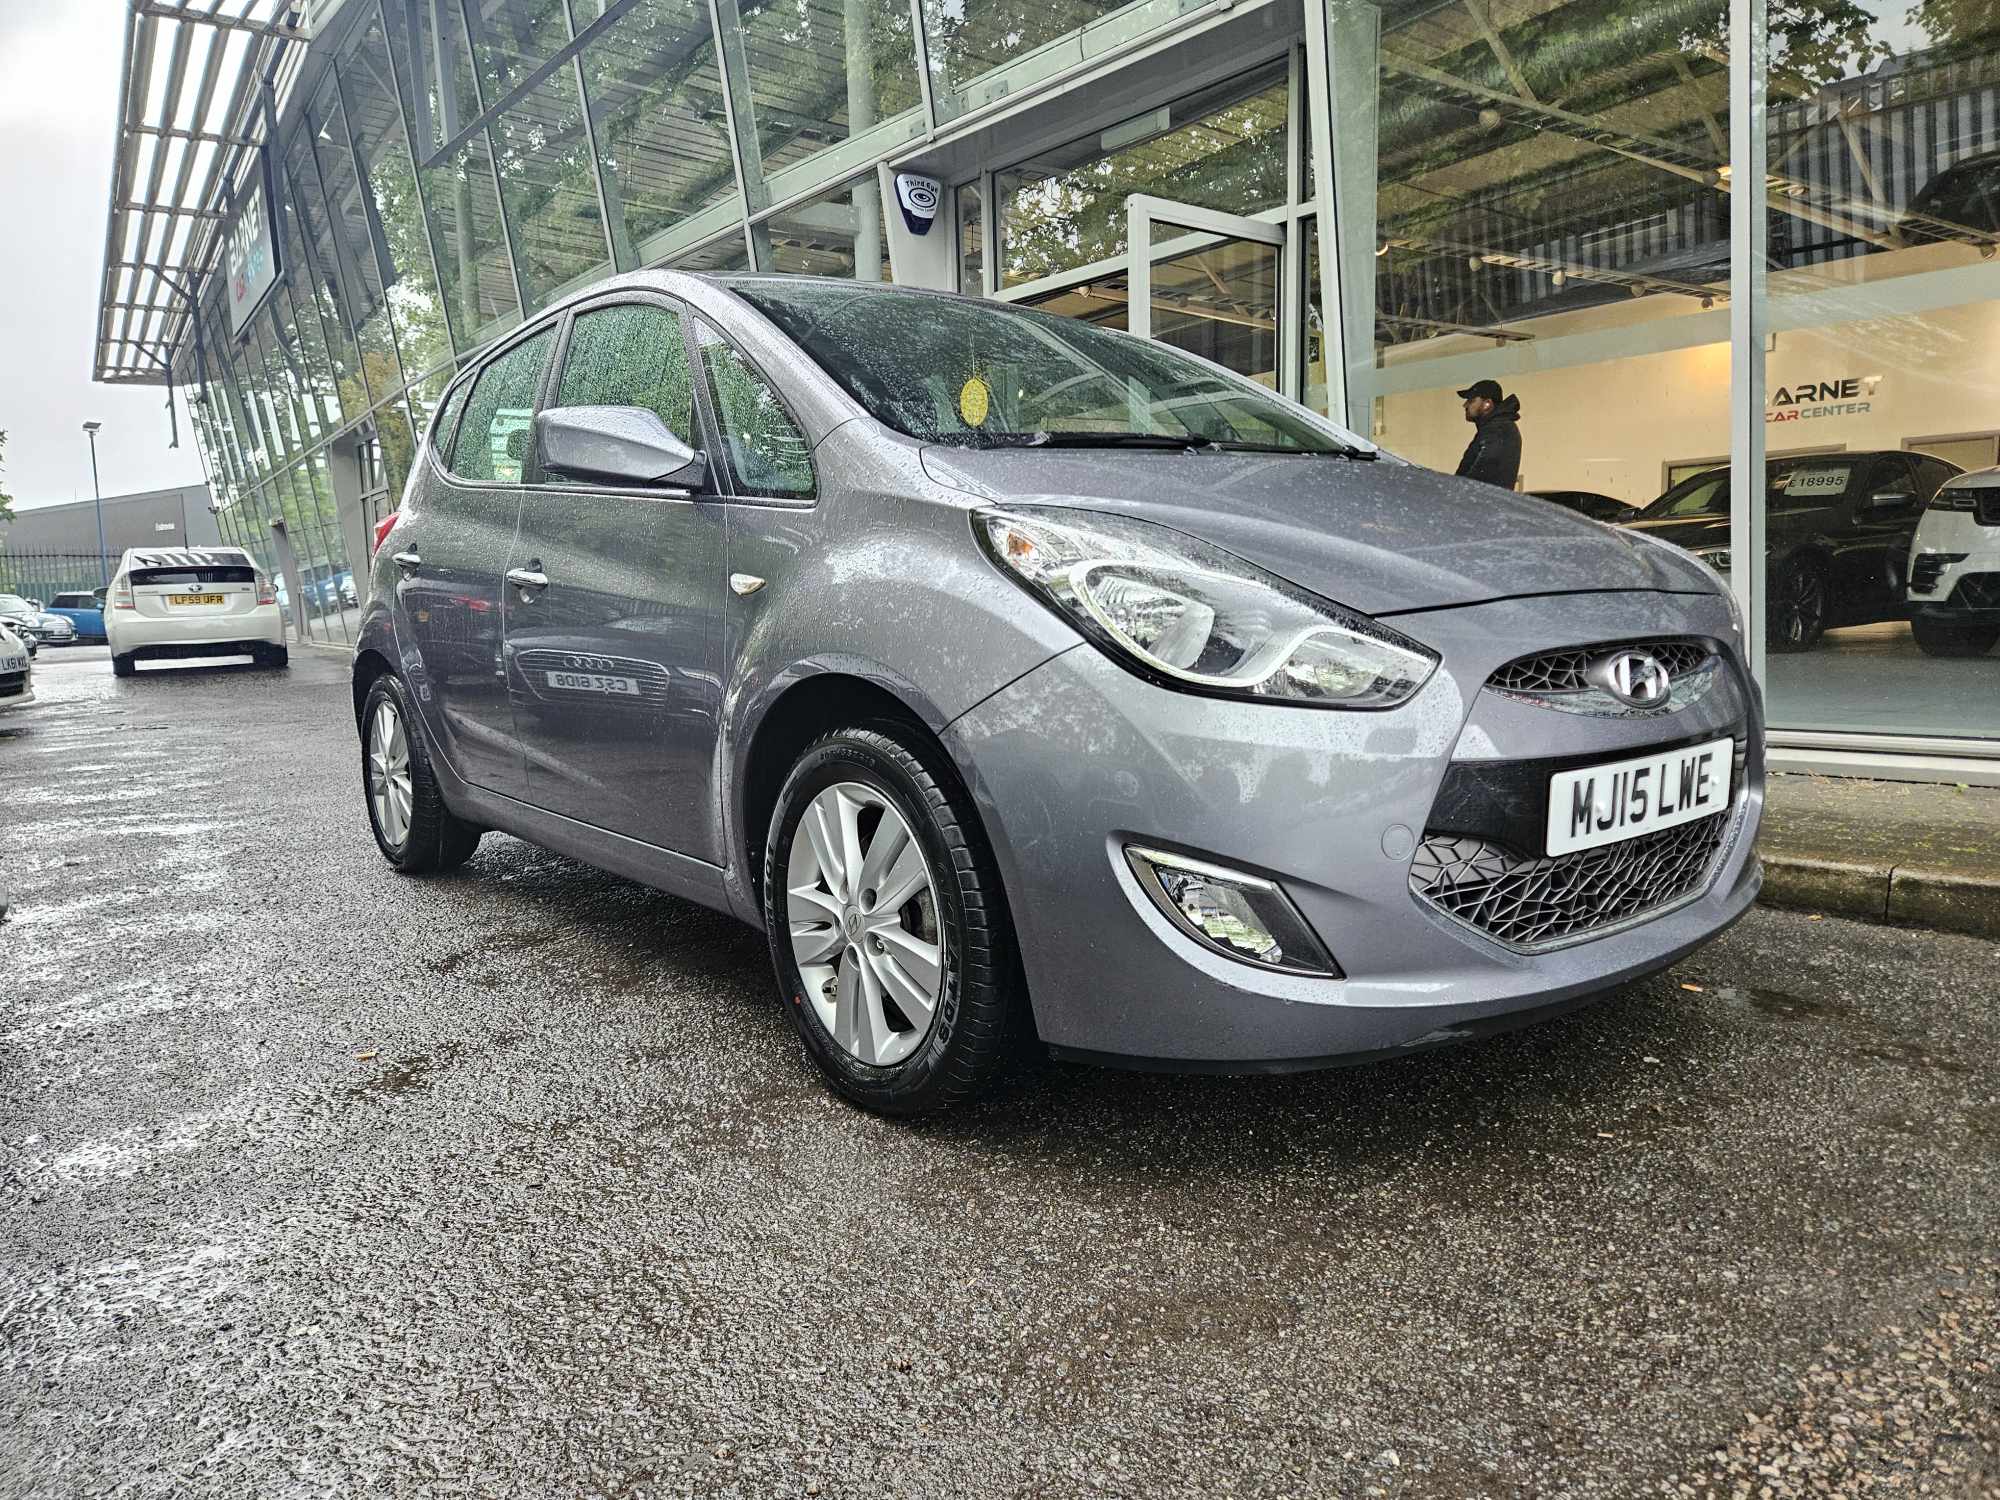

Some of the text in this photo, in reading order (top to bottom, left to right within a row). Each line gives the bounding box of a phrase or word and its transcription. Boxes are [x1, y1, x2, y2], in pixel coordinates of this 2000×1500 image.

[1765, 375, 1883, 406] ARNET
[1570, 752, 1713, 839] MJ15 LWE
